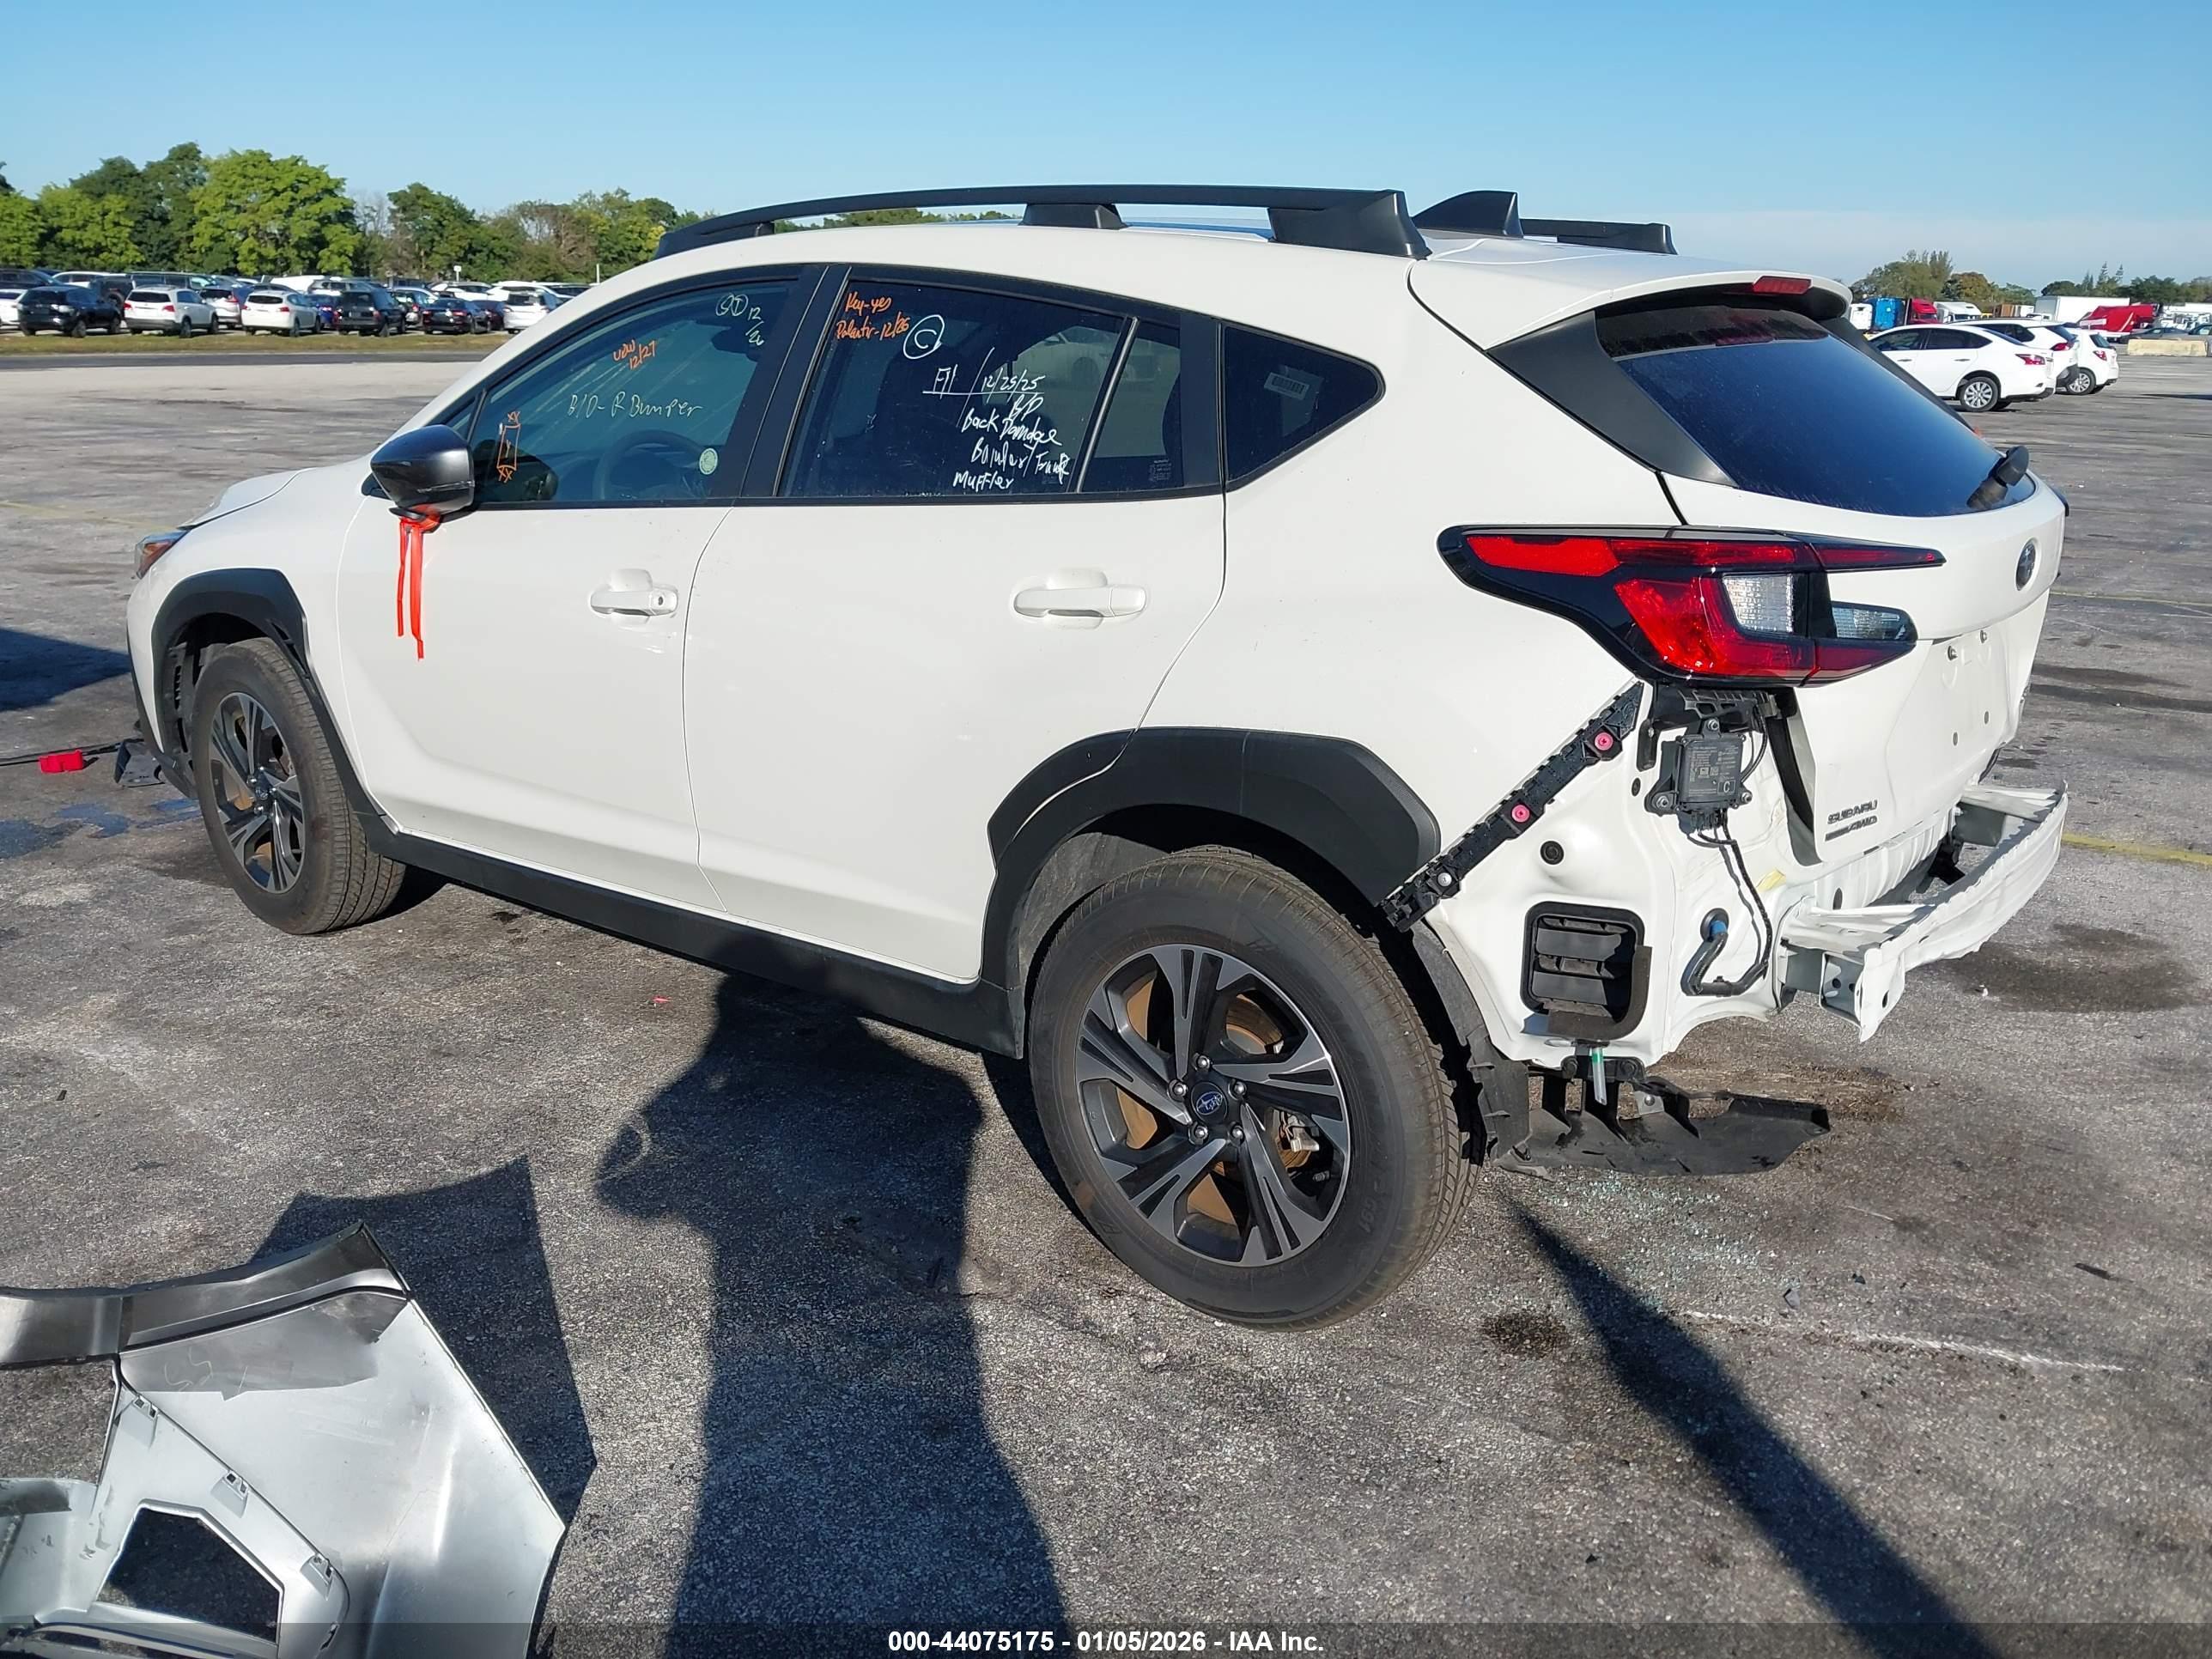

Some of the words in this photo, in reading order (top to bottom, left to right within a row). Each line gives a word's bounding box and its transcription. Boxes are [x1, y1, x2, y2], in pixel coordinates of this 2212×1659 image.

[611, 391, 626, 418] R
[1827, 799, 1878, 824] SUBARU
[1848, 815, 1878, 832] AWD
